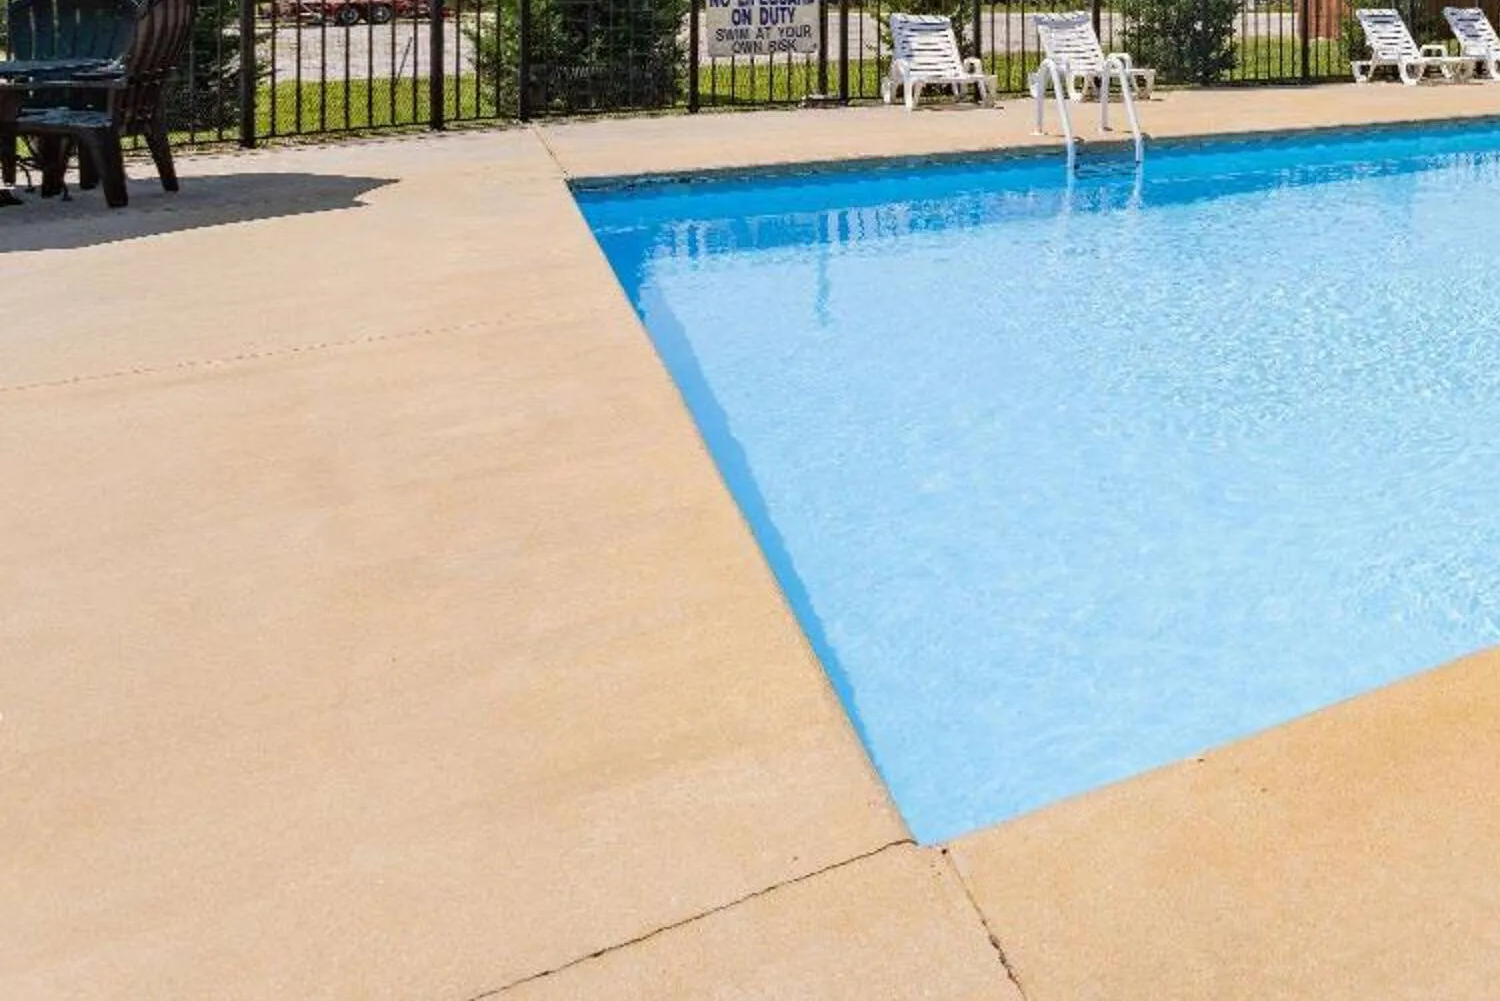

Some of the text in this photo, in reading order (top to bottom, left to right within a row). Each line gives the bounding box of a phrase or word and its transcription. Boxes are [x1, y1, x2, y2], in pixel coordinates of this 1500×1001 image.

[732, 7, 796, 25] ON DUTY
[715, 25, 812, 41] SWIM AT YOUR
[732, 41, 762, 53] OWN
